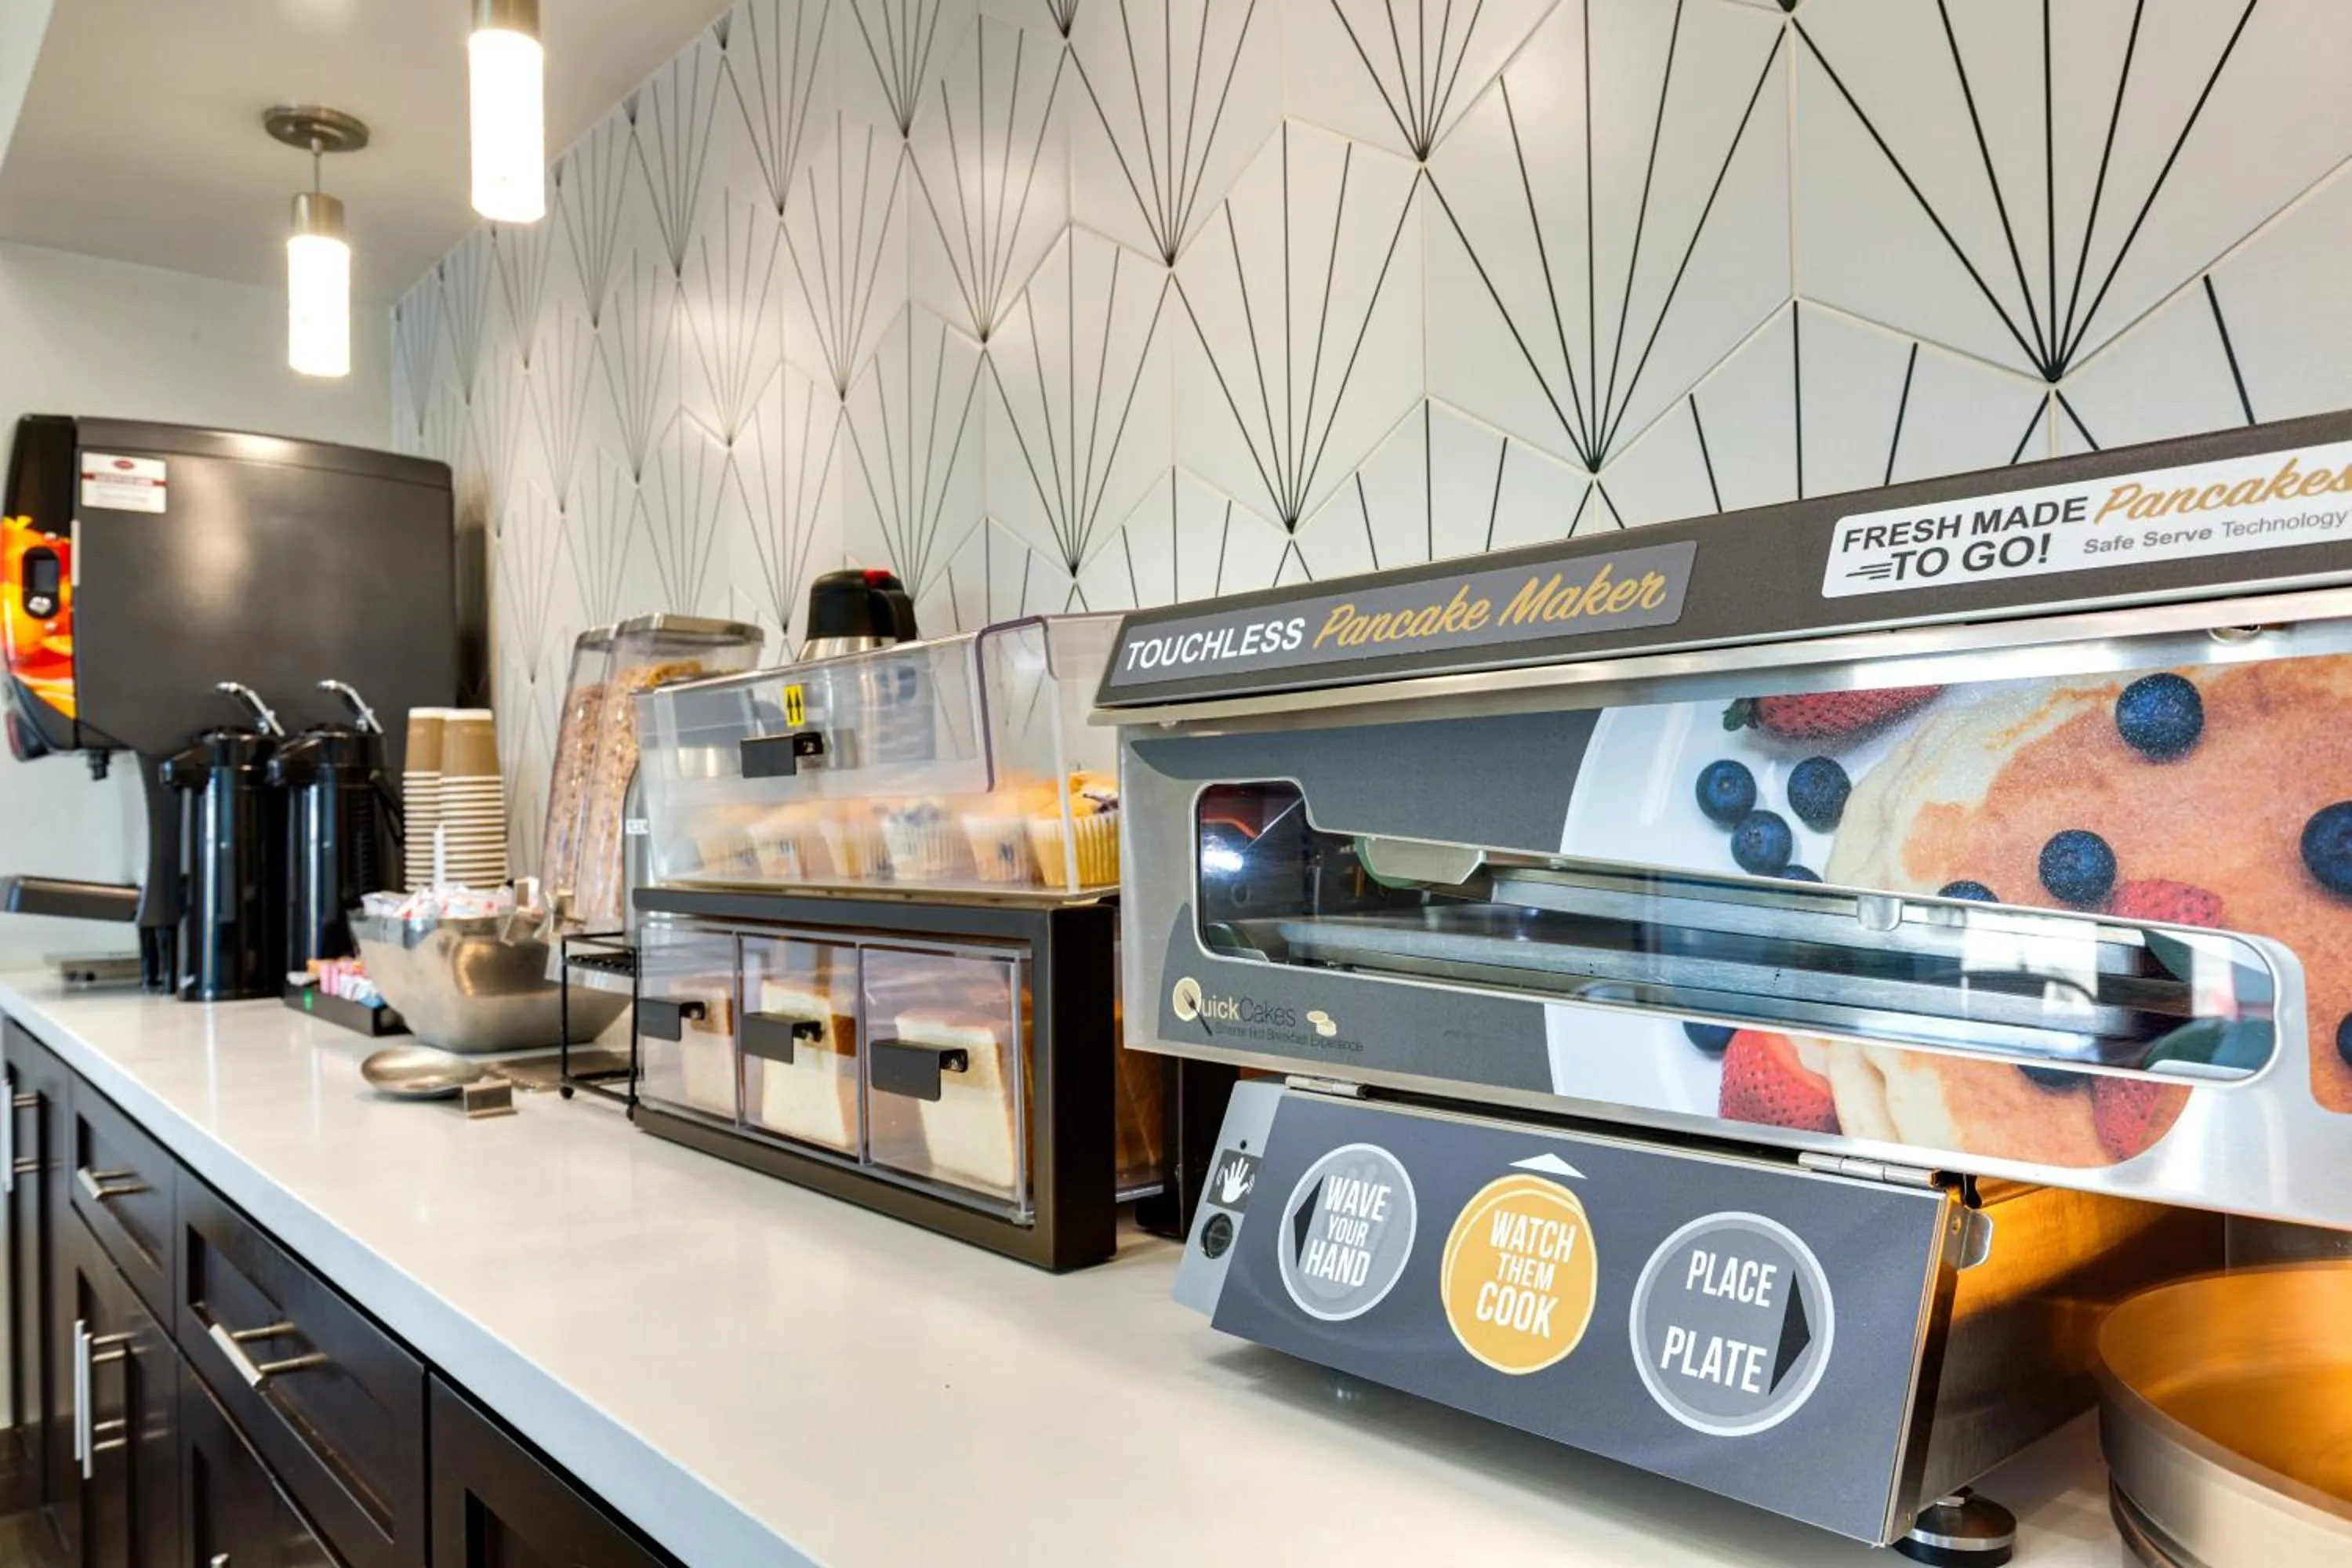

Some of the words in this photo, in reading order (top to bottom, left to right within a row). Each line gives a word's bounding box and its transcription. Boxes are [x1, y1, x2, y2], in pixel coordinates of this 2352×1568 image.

[1842, 514, 1962, 553] FRESH
[1970, 495, 2089, 536] MADE
[2092, 456, 2352, 524] Pancakes
[1891, 546, 1950, 581] TO
[1962, 532, 2052, 572] GO!
[2083, 535, 2135, 554] Safe
[2143, 526, 2212, 548] Serve
[2222, 510, 2349, 539] Technology
[1126, 617, 1306, 672] TOUCHLESS
[1312, 583, 1490, 650] Pancake
[1497, 562, 1667, 627] Maker
[1324, 1175, 1392, 1221] WAVE
[1327, 1214, 1369, 1247] YOUR
[1490, 1210, 1577, 1263] WATCH
[1304, 1239, 1371, 1287] HAND
[1497, 1251, 1555, 1292] THEM
[1686, 1249, 1777, 1308] PLACE
[1475, 1280, 1559, 1339] COOK
[1660, 1325, 1768, 1394] PLATE
